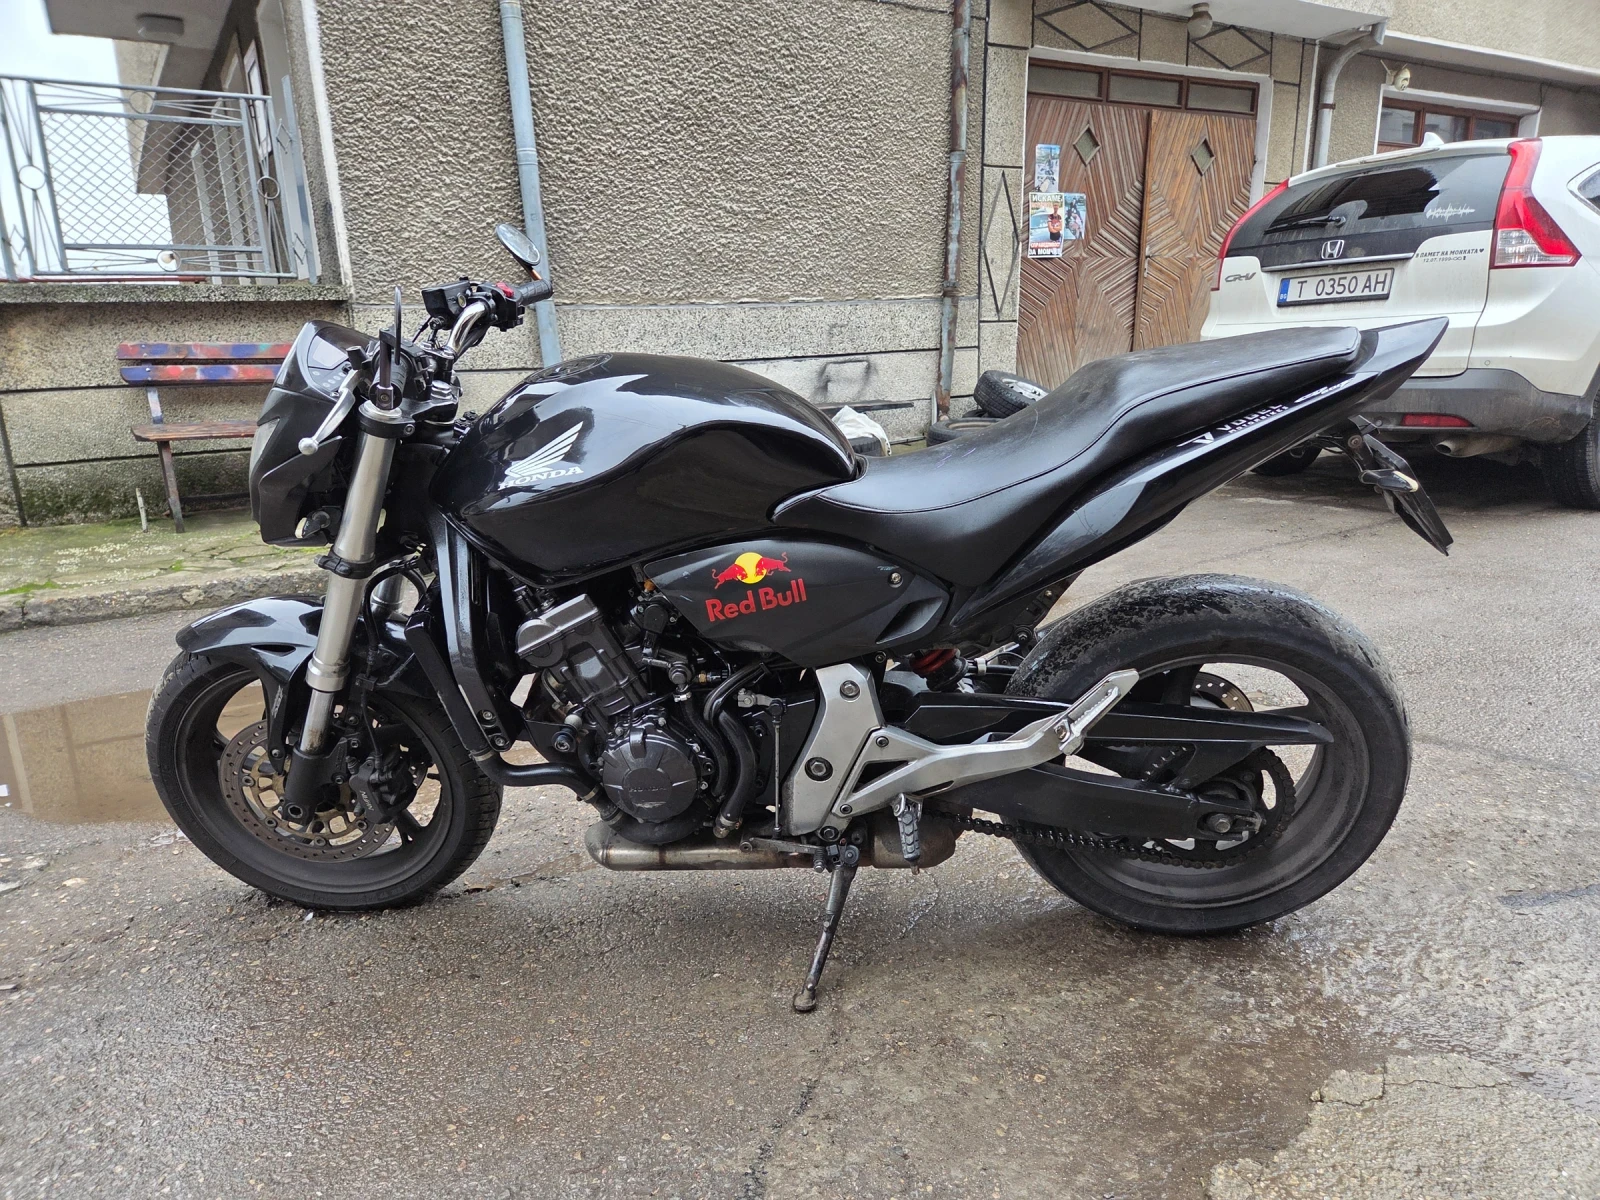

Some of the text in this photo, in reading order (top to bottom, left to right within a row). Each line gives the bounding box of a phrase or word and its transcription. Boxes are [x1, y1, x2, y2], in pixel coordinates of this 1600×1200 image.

[1297, 273, 1388, 298] T 0350 AH
[497, 466, 584, 491] HONDA
[705, 578, 807, 622] Red Bull
